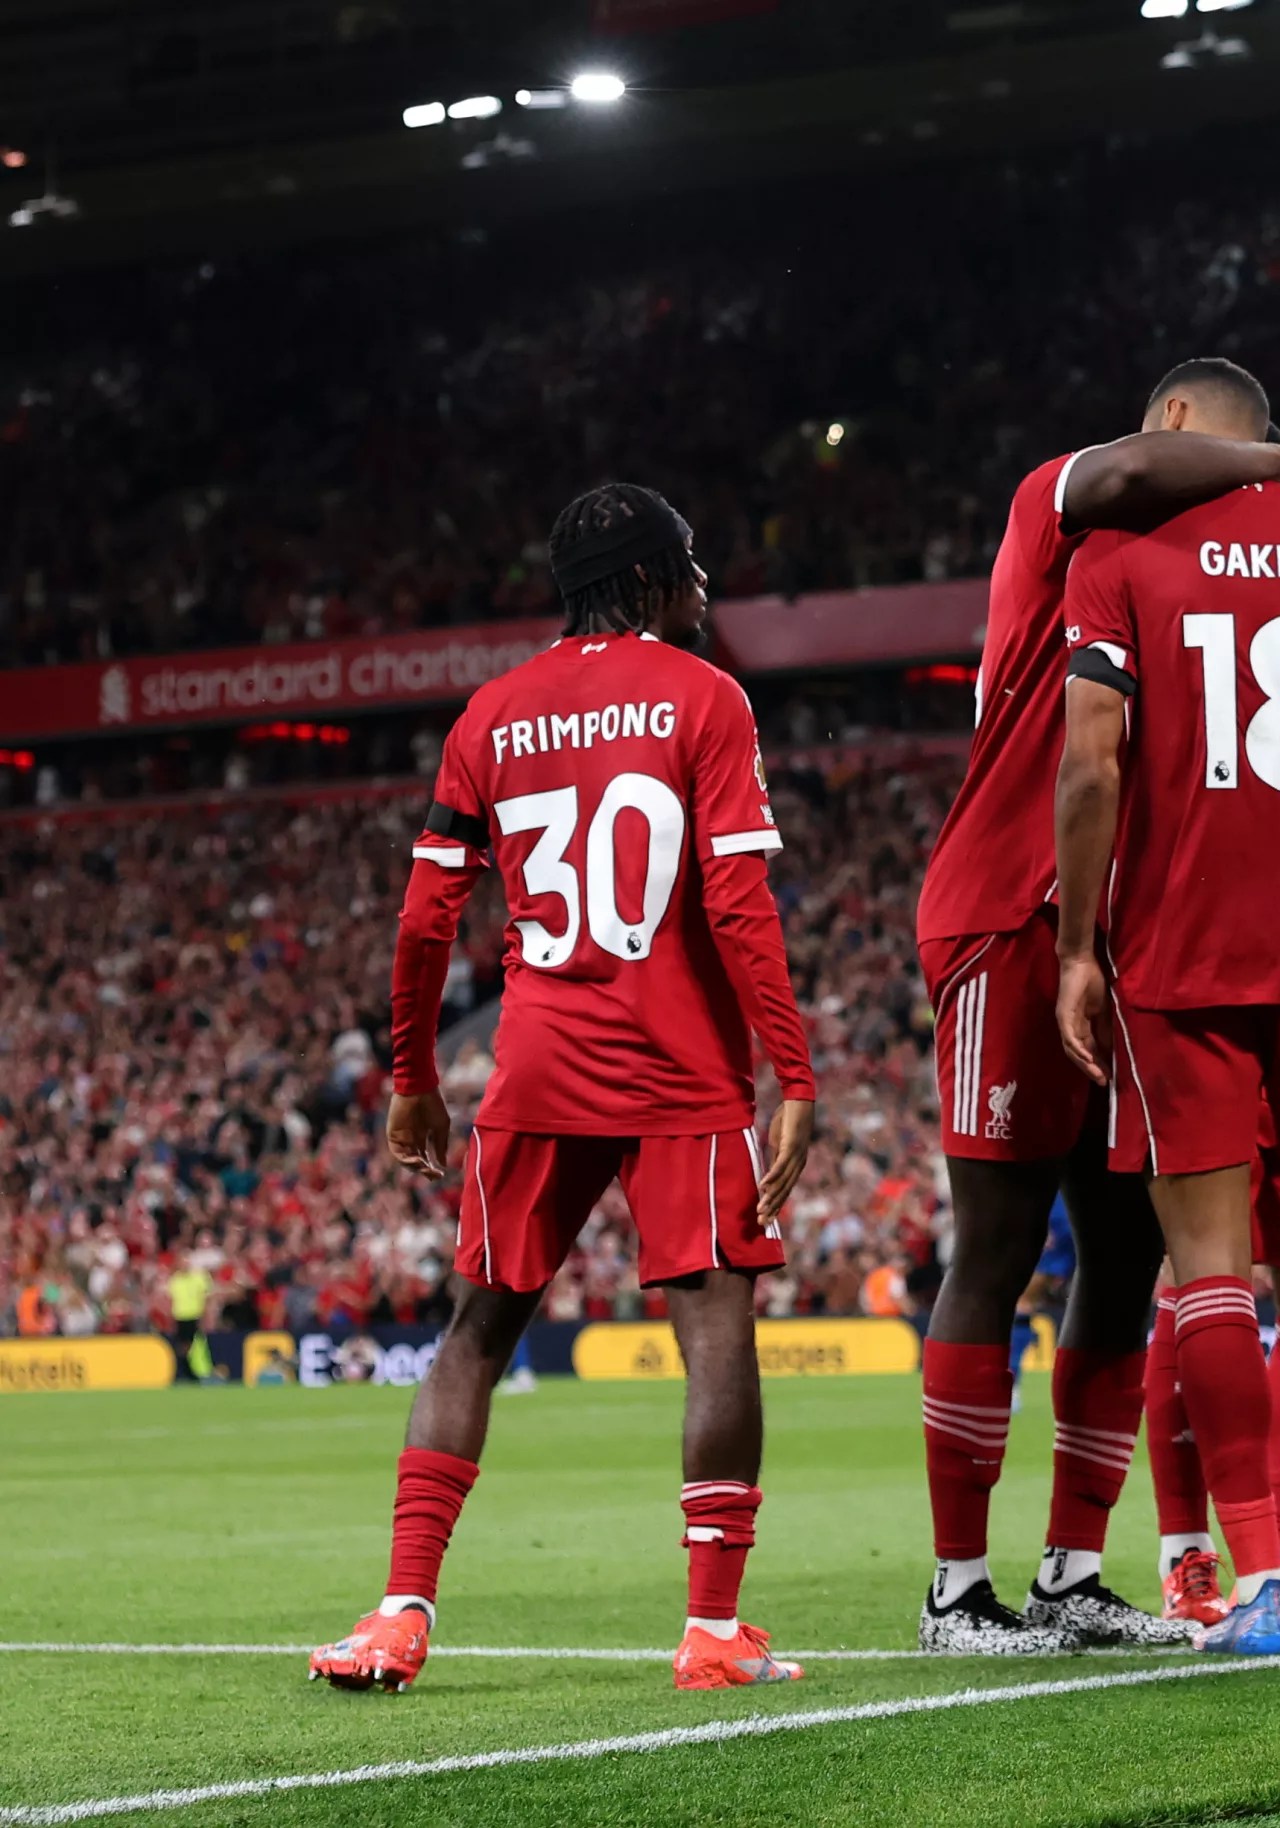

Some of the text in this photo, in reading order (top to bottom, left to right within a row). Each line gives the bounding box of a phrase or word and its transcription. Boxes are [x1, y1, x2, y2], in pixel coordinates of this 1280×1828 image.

[141, 660, 341, 716] standard
[491, 701, 676, 765] FRIMPONG
[493, 772, 686, 969] 30
